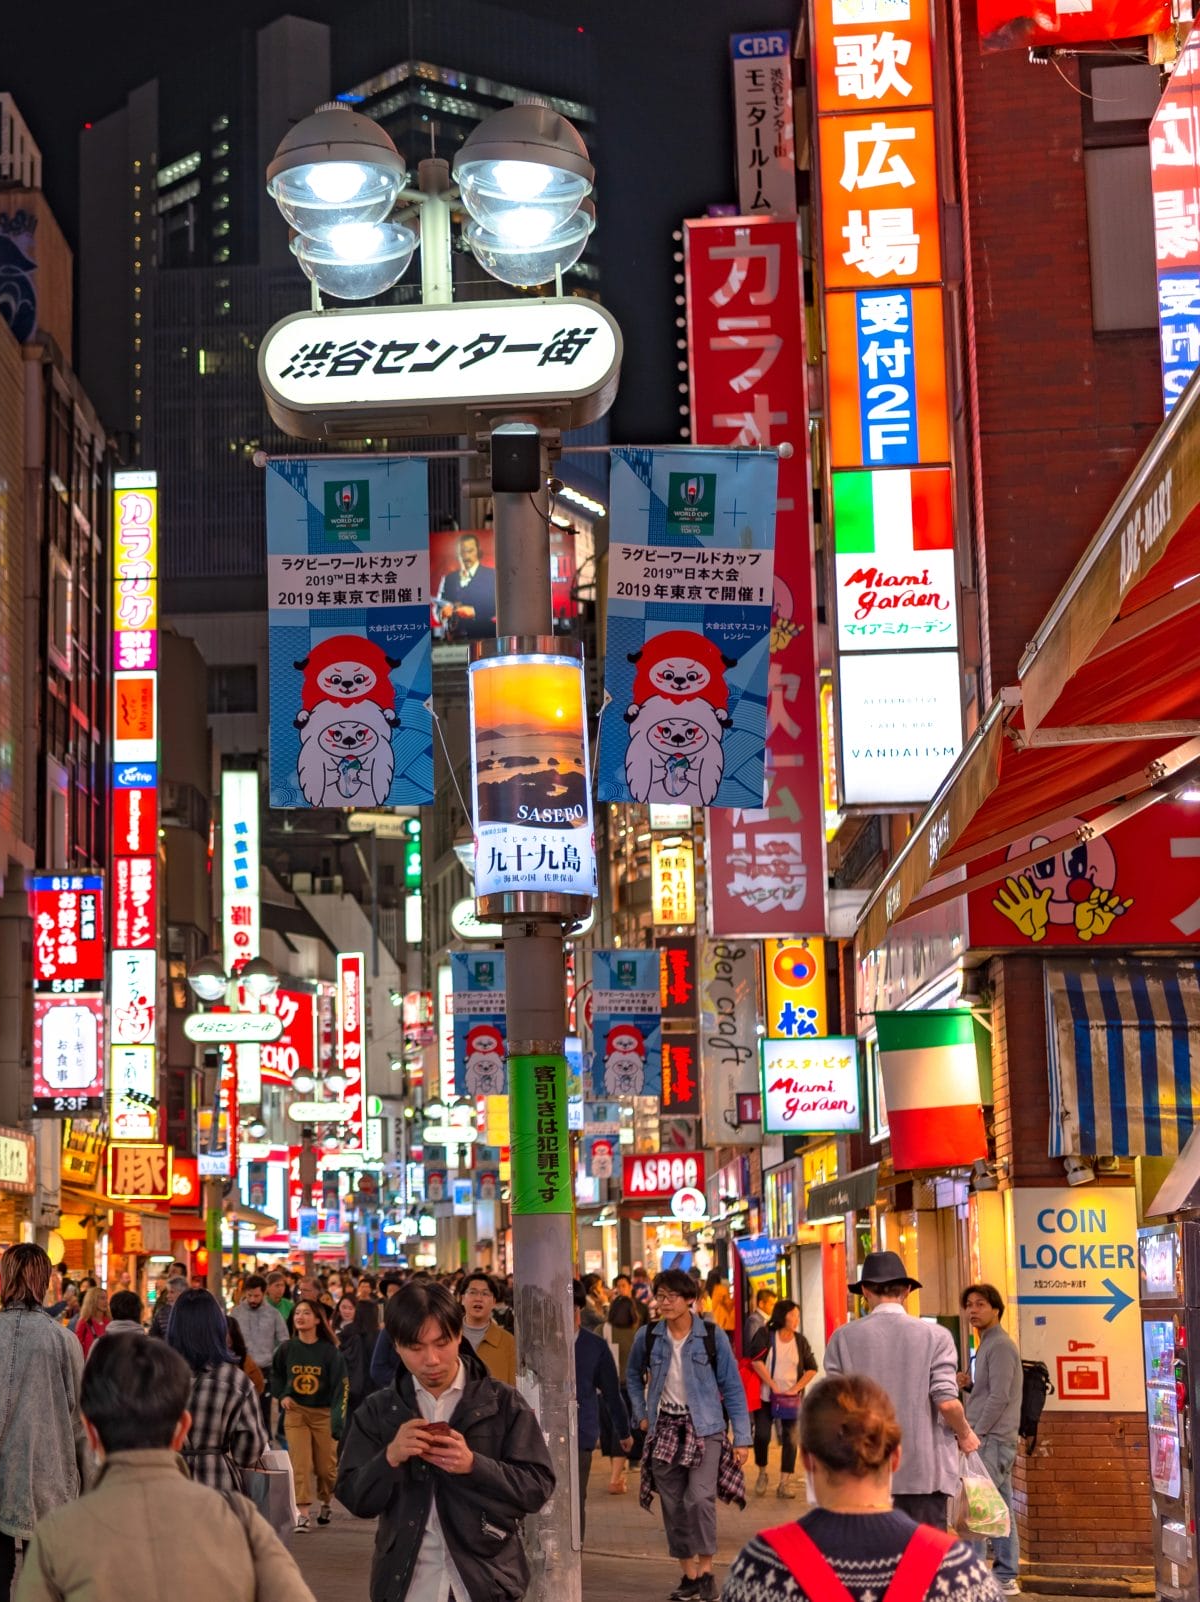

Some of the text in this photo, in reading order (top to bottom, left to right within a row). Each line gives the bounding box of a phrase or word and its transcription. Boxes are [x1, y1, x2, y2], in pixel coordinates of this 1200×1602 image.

[738, 36, 784, 57] CBR
[745, 69, 772, 210] モニタールーム
[834, 31, 921, 278] 歌広場
[280, 327, 598, 380] 渋谷センター街
[861, 295, 911, 461] 受付2F
[1119, 468, 1173, 595] ABC-MART
[281, 554, 417, 573] ラグビーワールドカップ
[621, 548, 761, 566] ラグビーワールドカップ
[844, 567, 932, 588] Miami
[368, 623, 429, 634] 大会公式マスコット
[386, 632, 413, 641] レンジー
[706, 622, 769, 632] 大会公式マスコット
[724, 632, 751, 641] レンジー
[852, 747, 955, 758] VANDALISM
[516, 804, 584, 823] SASEBO
[486, 844, 581, 875] 九十九島
[504, 873, 574, 883] 海風の国 佐世保市
[37, 912, 56, 978] もんじゃ
[777, 1002, 817, 1036] 松
[57, 1039, 69, 1082] お食事
[768, 1078, 836, 1093] Miami
[533, 1065, 560, 1203] 客引きは犯罪です
[115, 1148, 166, 1195] 豚
[1037, 1208, 1107, 1234] COIN
[1020, 1244, 1136, 1270] LOCKER
[292, 1365, 321, 1376] GUCCI
